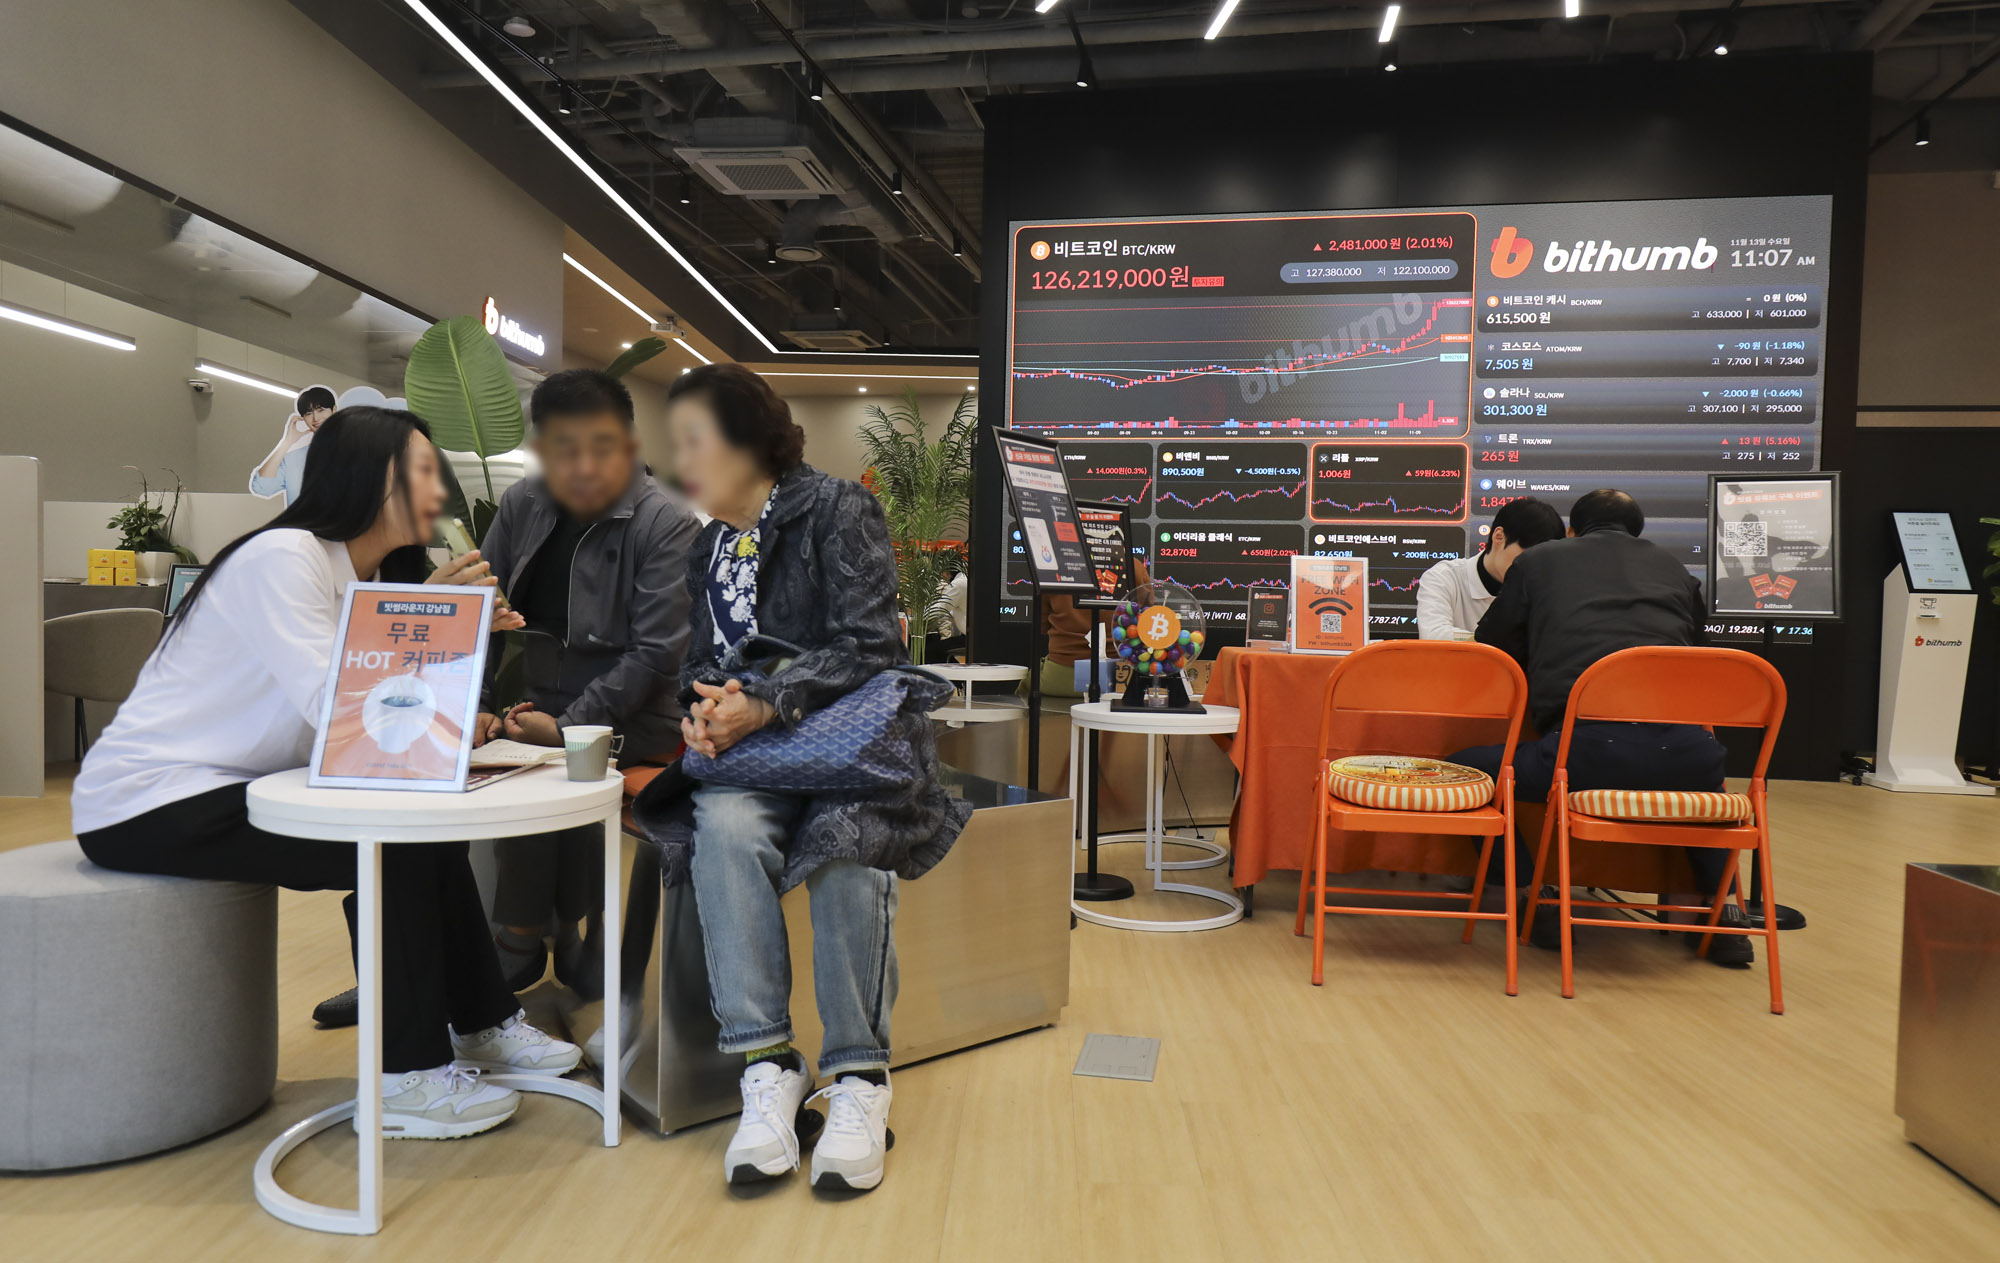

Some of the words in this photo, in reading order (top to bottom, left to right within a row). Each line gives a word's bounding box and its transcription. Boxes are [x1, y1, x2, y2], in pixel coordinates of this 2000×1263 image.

[1329, 239, 1388, 252] 2,481,000
[1390, 237, 1401, 250] 원
[1406, 236, 1453, 250] (2.01%)
[1730, 238, 1747, 246] 11월
[1749, 238, 1766, 246] 13일
[1767, 237, 1790, 245] 수요일
[1054, 239, 1118, 257] 비트코인
[1122, 244, 1176, 257] BTC/KRW
[1543, 237, 1718, 273] bithumb
[1731, 249, 1793, 267] 11:07
[1796, 256, 1816, 266] AM
[1291, 269, 1300, 277] 고
[1306, 267, 1362, 278] 127,380,000
[1377, 266, 1386, 276] 저
[1393, 266, 1450, 276] 122,100,000
[1503, 294, 1543, 306] 비트코인
[1546, 294, 1567, 305] 캐시
[1785, 293, 1807, 303] (0%)
[1486, 313, 1537, 325] 615,500
[1539, 311, 1551, 324] 원
[1691, 310, 1700, 318] 고
[1706, 310, 1742, 318] 633,000
[1755, 309, 1763, 318] 저
[1770, 309, 1807, 318] 601,000
[1239, 293, 1423, 403] bithumb
[1501, 342, 1542, 351] 코스모스
[1765, 341, 1805, 351] (-1.18%)
[1485, 359, 1519, 371] 7,505
[1521, 358, 1533, 371] 원
[1727, 357, 1751, 366] 7,700
[1764, 357, 1772, 366] 저
[1779, 357, 1805, 366] 7,340
[1499, 387, 1531, 398] 솔라나
[1763, 388, 1803, 398] (-0.66%)
[1483, 405, 1533, 417] 301,300
[1535, 404, 1547, 417] 원
[1688, 405, 1696, 413] 고
[1702, 405, 1739, 413] 307,100
[1750, 404, 1759, 413] 저
[1766, 405, 1803, 413] 295,000
[1497, 433, 1519, 444] 트론
[1765, 436, 1801, 446] (5.16%)
[1175, 452, 1200, 461] 비엔비
[1332, 453, 1349, 463] 리플
[1481, 451, 1505, 462] 265
[1507, 450, 1519, 463] 원
[1737, 452, 1754, 460] 275
[1767, 452, 1776, 460] 저
[1782, 452, 1800, 460] 252
[1496, 479, 1527, 490] 웨이브
[1173, 532, 1206, 542] 이더리움
[1208, 532, 1232, 542] 클래식
[1328, 534, 1396, 544] 비트코인에스브이
[1314, 585, 1346, 595] ZONE
[384, 602, 425, 613] 빗썸라운지
[426, 603, 451, 614] 강남점
[386, 622, 431, 644] 무료
[345, 650, 395, 670] HOT
